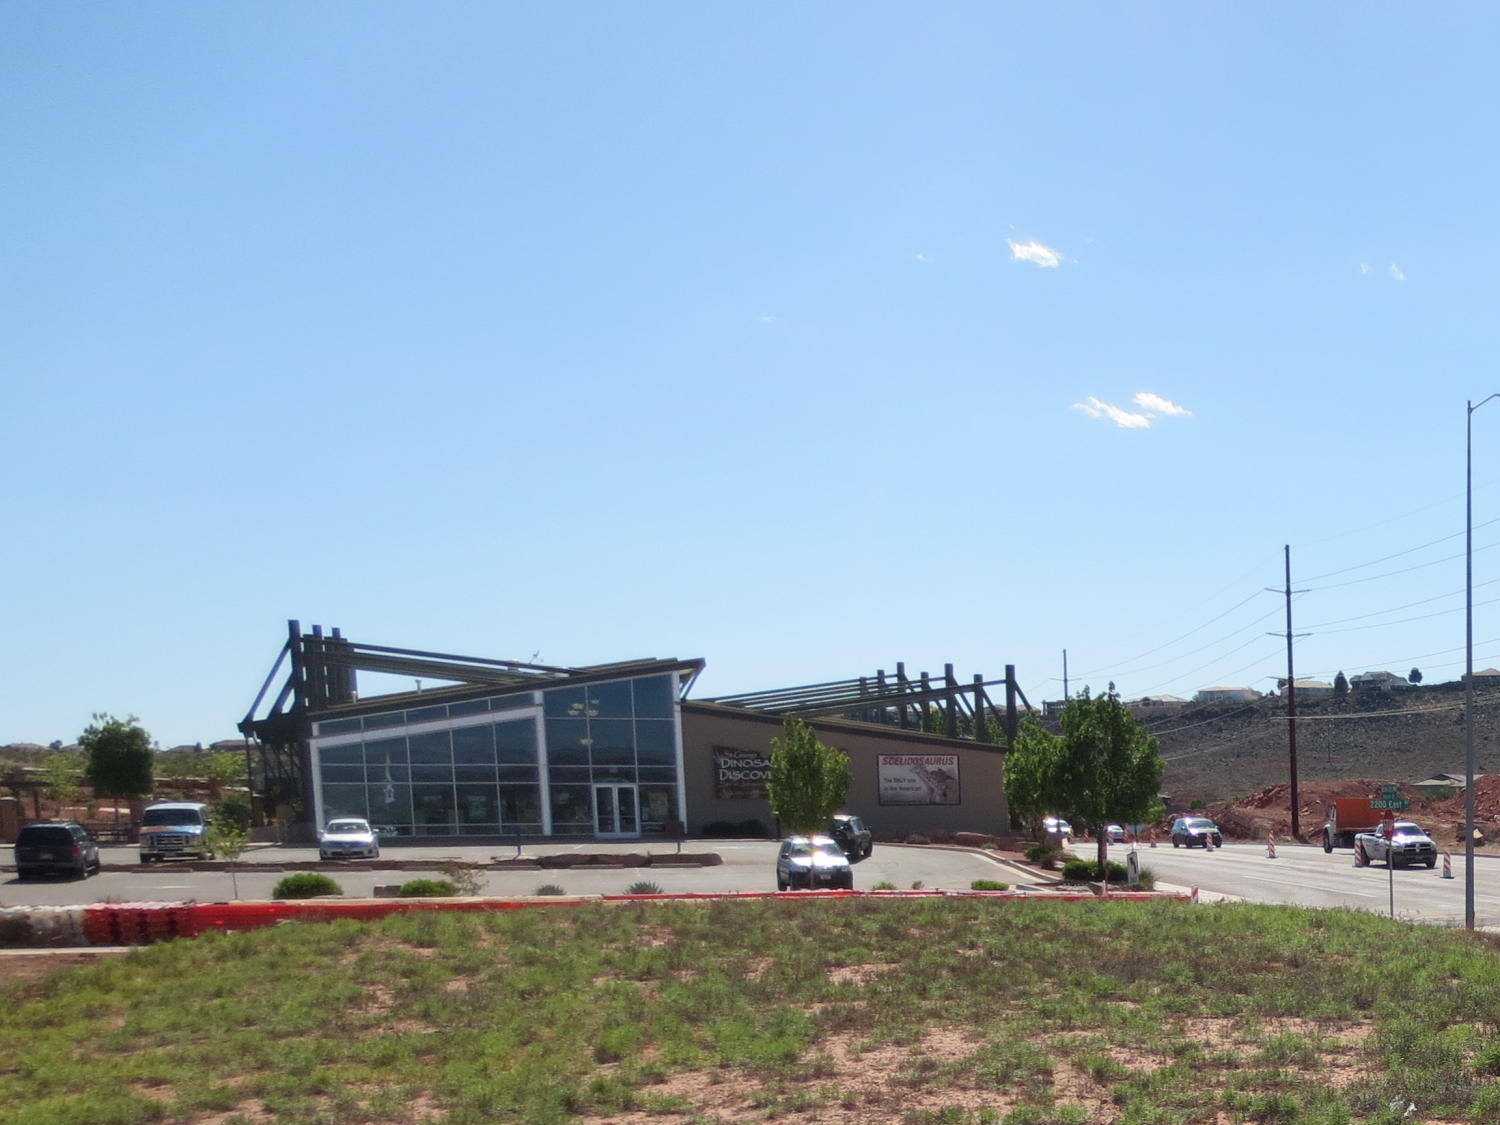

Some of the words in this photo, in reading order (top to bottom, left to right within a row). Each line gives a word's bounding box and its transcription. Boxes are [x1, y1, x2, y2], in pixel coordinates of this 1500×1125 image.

[721, 758, 772, 768] DINOSA
[882, 757, 954, 766] SCELIDOSAURUS
[720, 769, 772, 781] DISCOV
[1370, 800, 1387, 809] 2200
[1388, 800, 1402, 809] East
